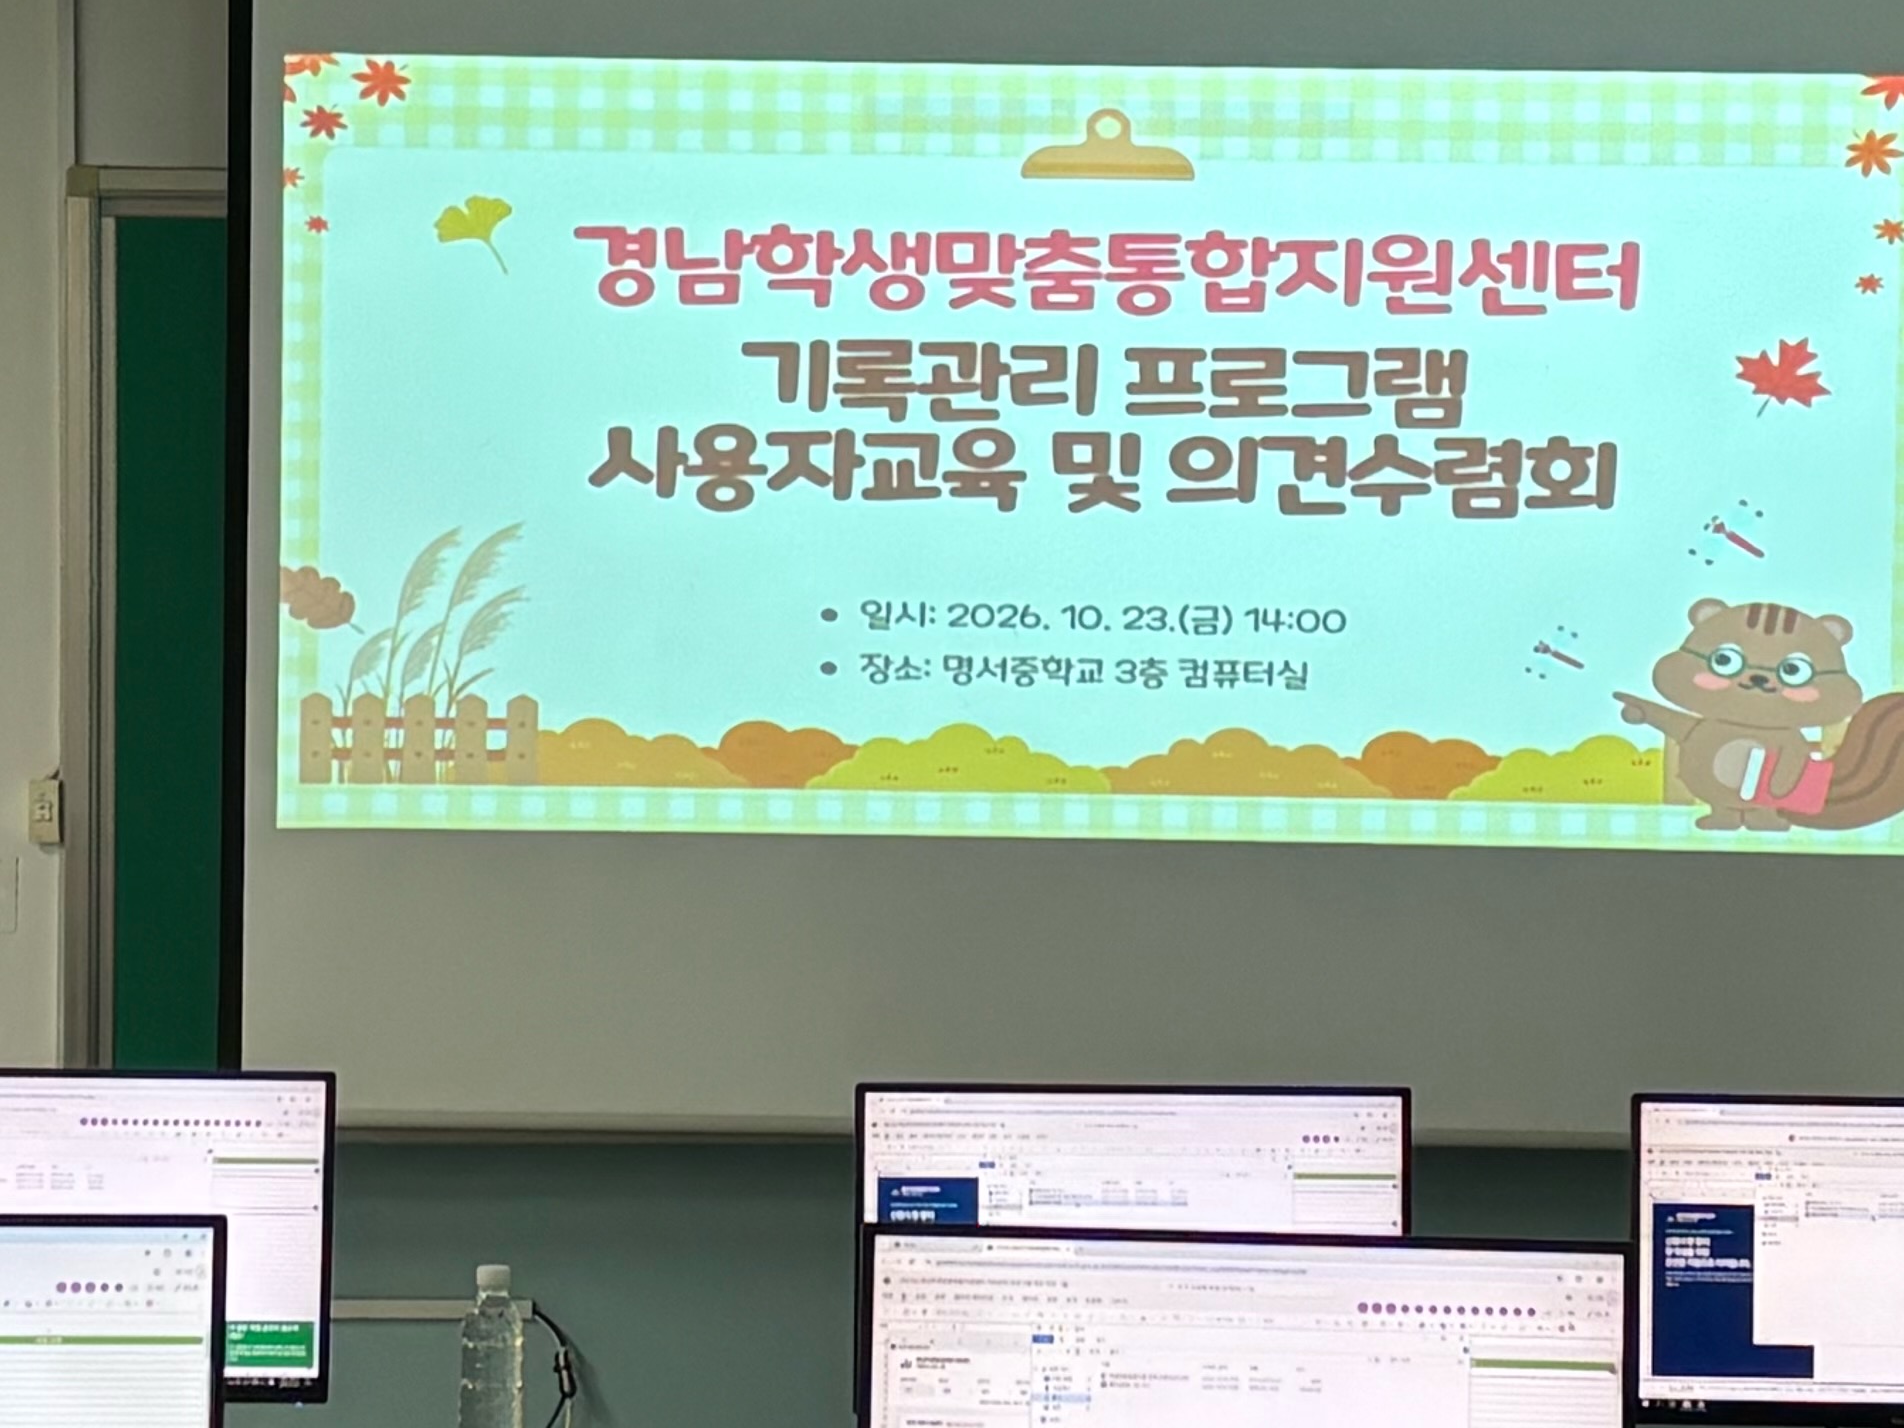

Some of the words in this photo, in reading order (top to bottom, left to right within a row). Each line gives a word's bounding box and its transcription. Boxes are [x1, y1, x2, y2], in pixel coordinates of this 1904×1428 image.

[574, 224, 1641, 317] 경남학생맞춤통합지원센터
[741, 339, 1100, 422] 기록관리
[1124, 347, 1469, 429] 프로그램
[588, 423, 1029, 513] 사용자교육
[1052, 431, 1142, 514] 및
[1166, 433, 1618, 520] 의견수렴회
[861, 601, 936, 631] 일시:
[948, 604, 1050, 631] 2026.
[1062, 605, 1111, 631] 10.
[1123, 605, 1233, 637] 23.(금)
[1245, 608, 1348, 634] 14:00
[861, 654, 932, 686] 장소:
[944, 655, 1104, 688] 명서중학교
[1116, 658, 1169, 690] 3층
[1179, 659, 1309, 692] 컴퓨터실
